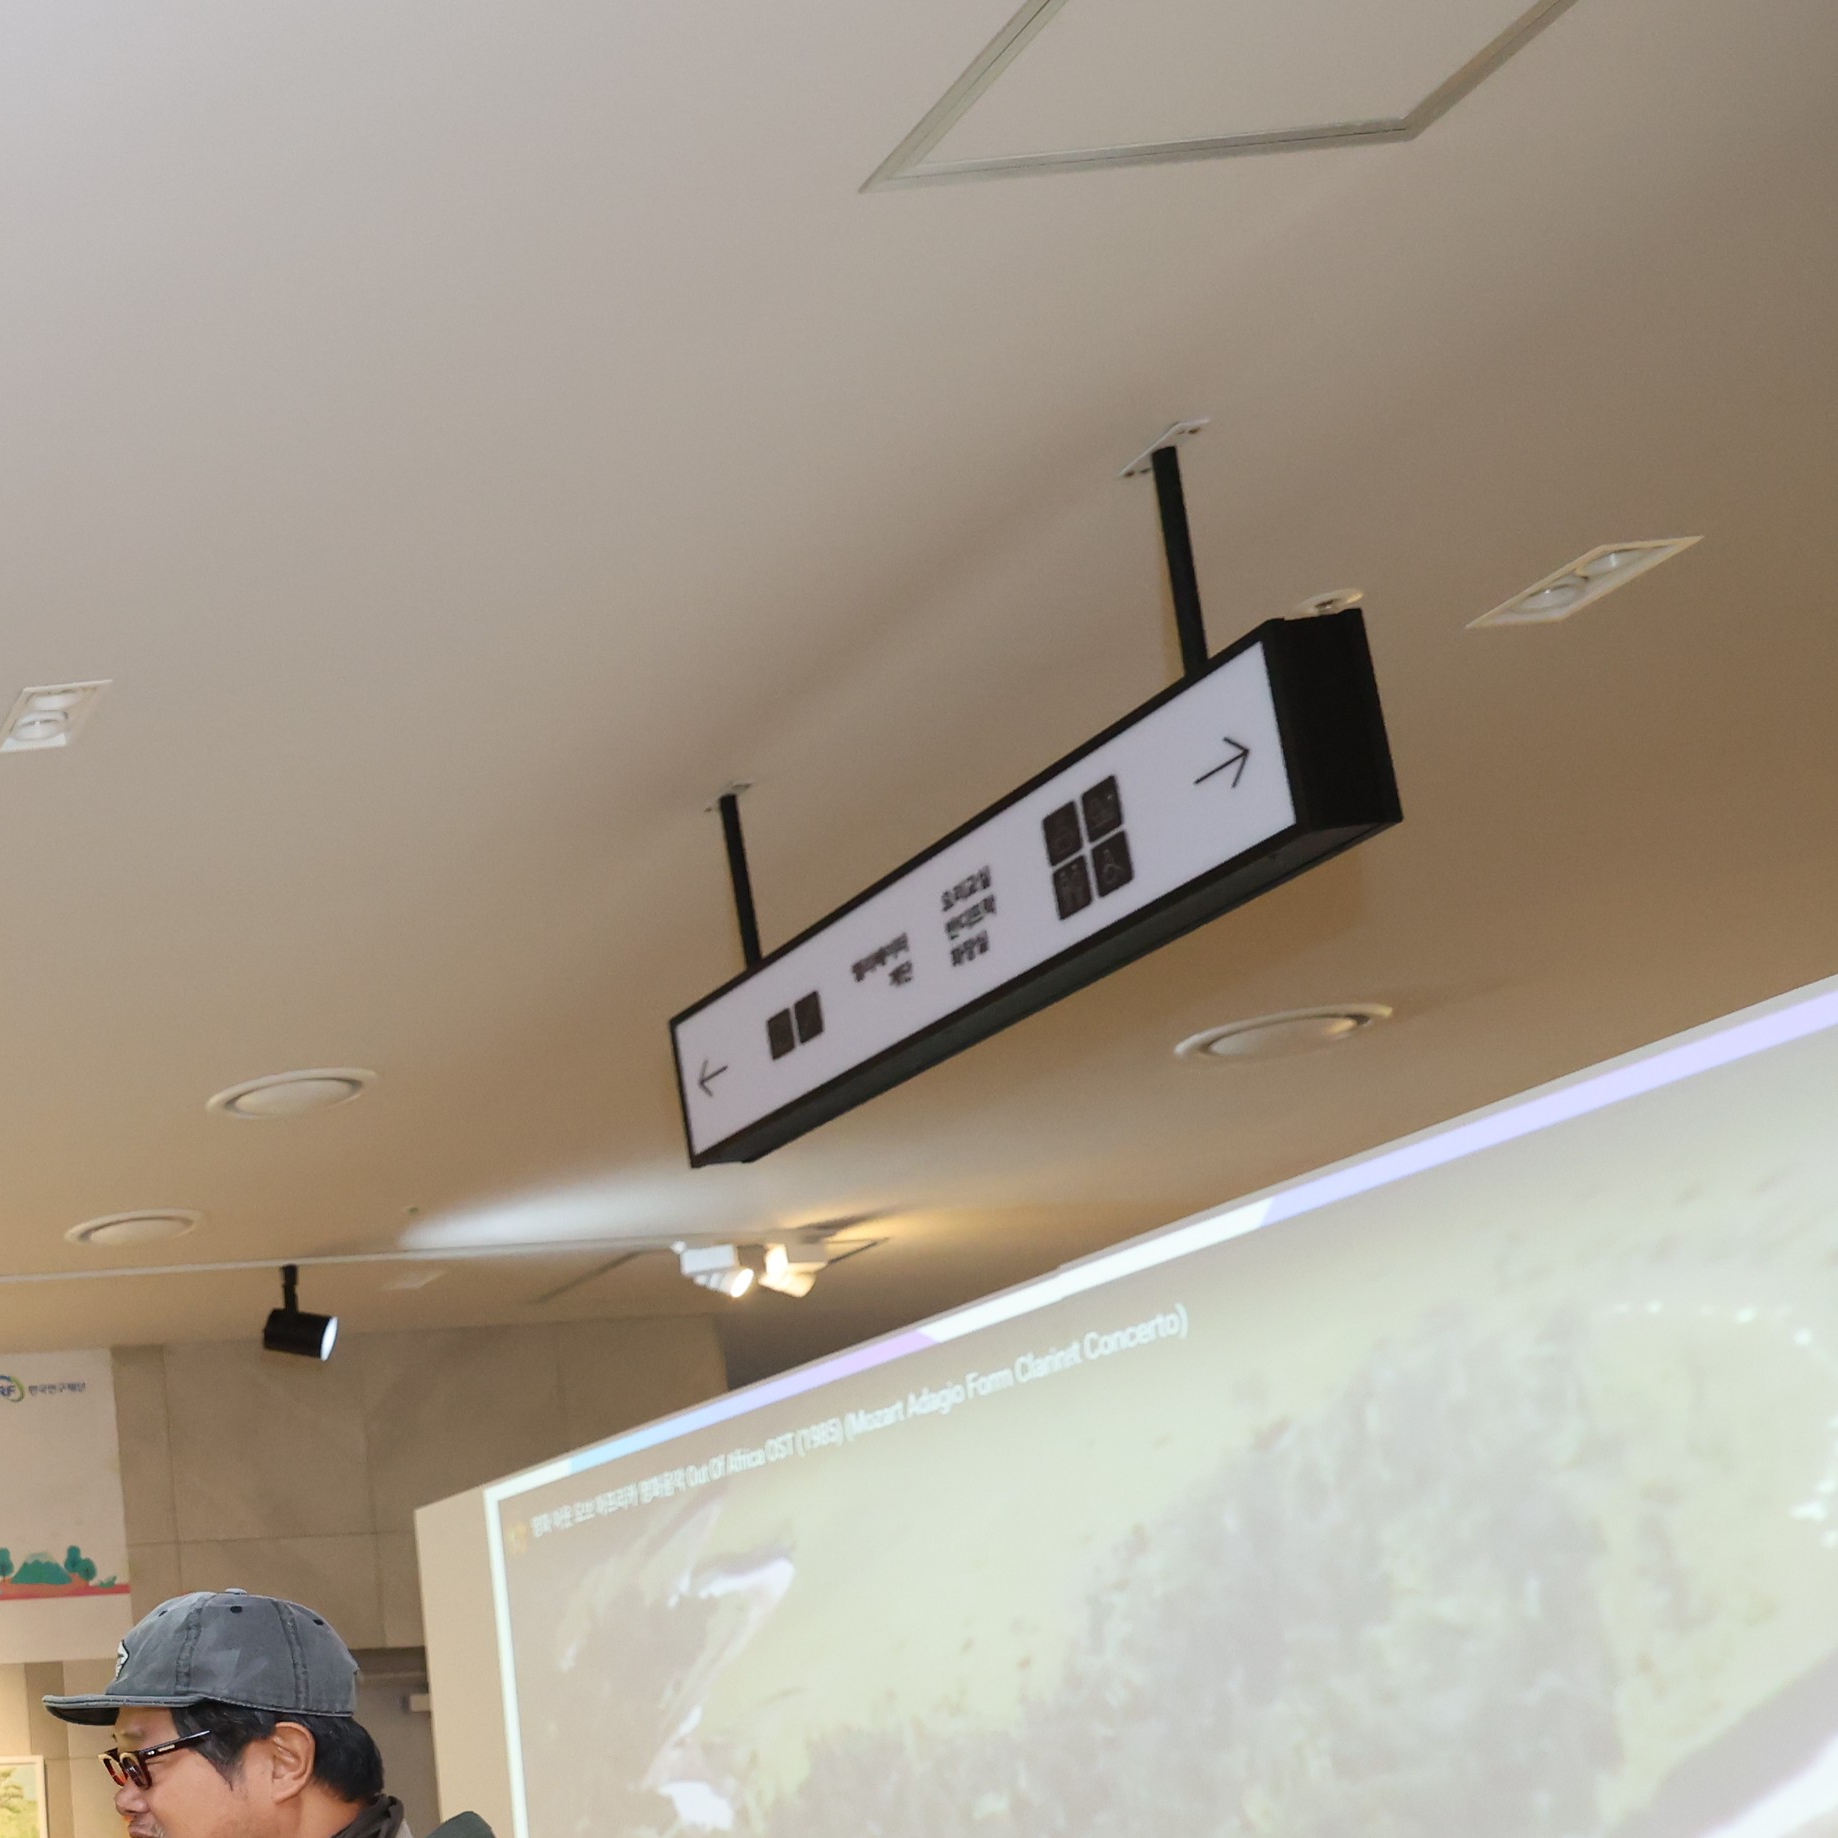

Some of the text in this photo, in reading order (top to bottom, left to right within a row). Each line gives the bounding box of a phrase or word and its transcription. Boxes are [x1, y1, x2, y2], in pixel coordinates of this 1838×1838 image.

[765, 1432, 796, 1463] OST
[844, 1409, 906, 1442] (Mozart
[906, 1381, 966, 1416] Adagio
[1014, 1342, 1083, 1384] Clarinet
[1083, 1302, 1190, 1361] Concerto)
